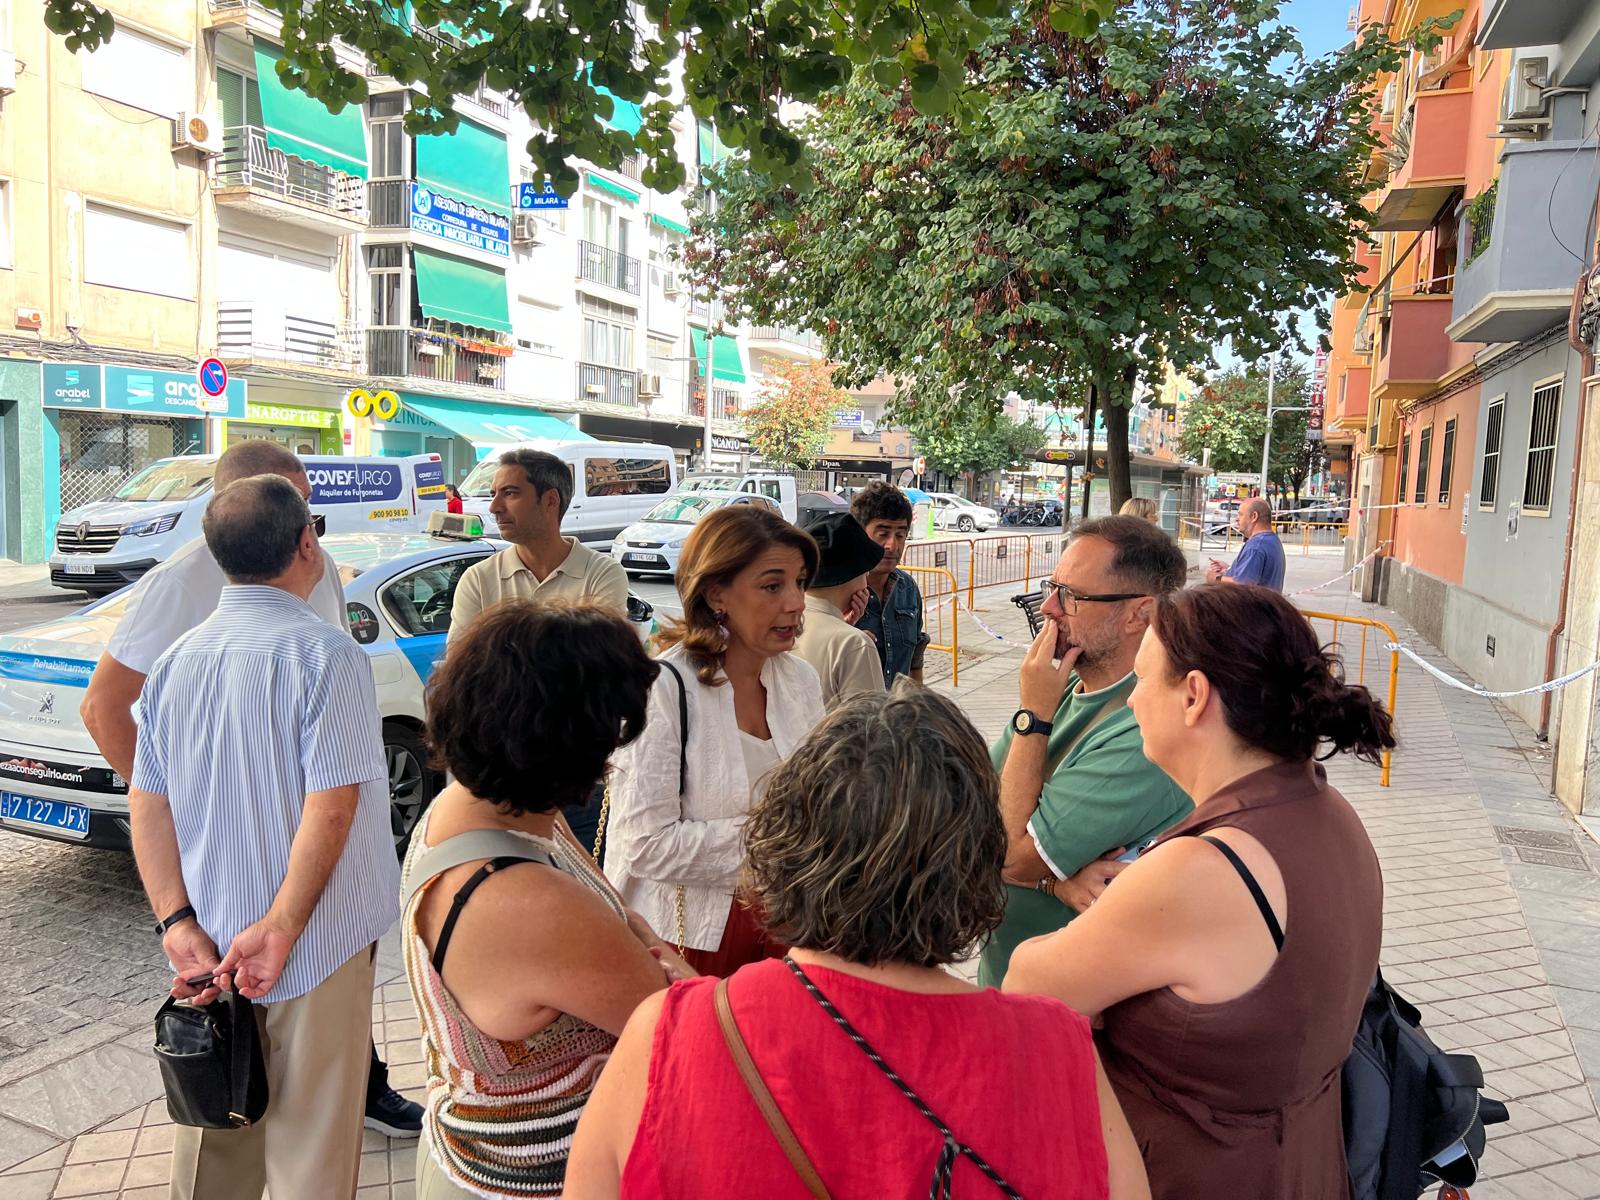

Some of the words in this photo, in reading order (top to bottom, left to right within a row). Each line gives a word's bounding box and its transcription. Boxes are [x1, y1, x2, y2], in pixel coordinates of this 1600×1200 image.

[534, 197, 559, 205] MILARA
[413, 216, 442, 236] AGENCIA
[485, 238, 508, 256] MILARA
[55, 388, 90, 398] arabel
[385, 409, 437, 427] LINICA
[319, 489, 343, 498] Alquiler
[352, 489, 384, 497] Furgonetas
[32, 658, 91, 674] Rehabilitamos
